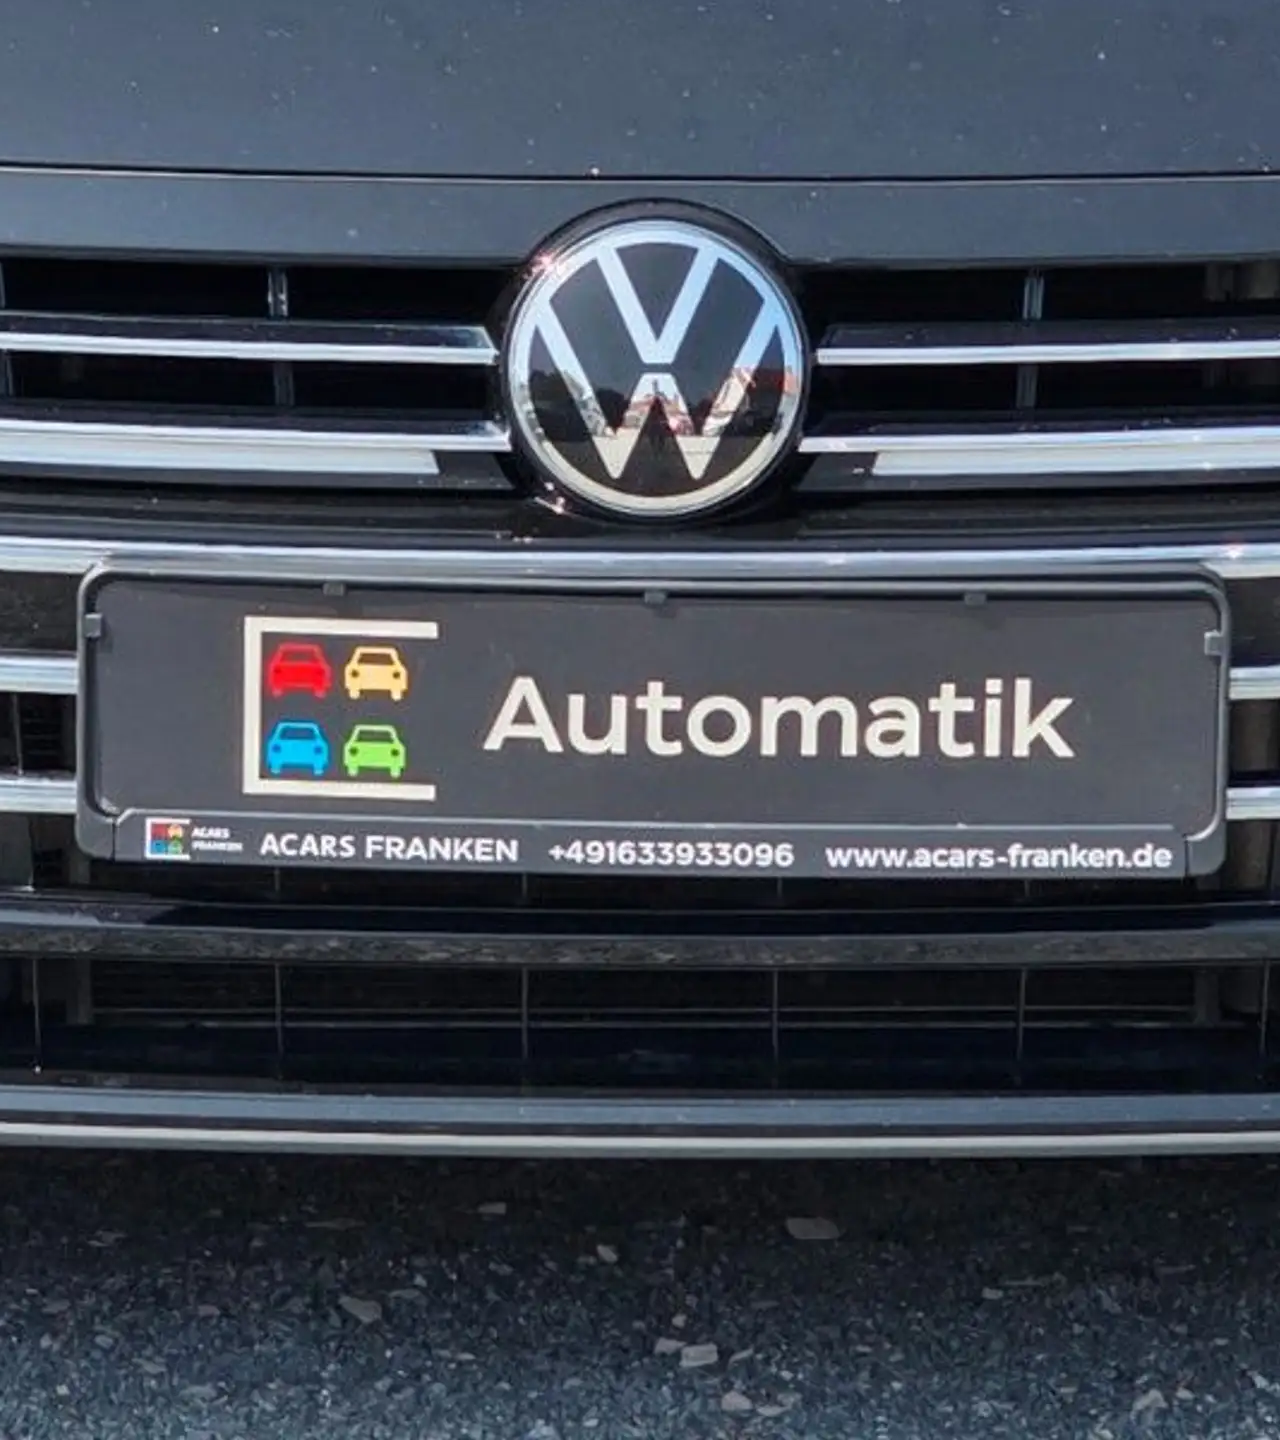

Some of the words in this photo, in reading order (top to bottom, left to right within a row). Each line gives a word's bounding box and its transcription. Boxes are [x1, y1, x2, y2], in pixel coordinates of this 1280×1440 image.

[483, 676, 1074, 760] Automatik
[260, 833, 355, 858] ACARS
[365, 837, 518, 862] FRANKEN
[548, 841, 794, 867] +491633933096
[826, 843, 1173, 869] www.acars-franken.de
